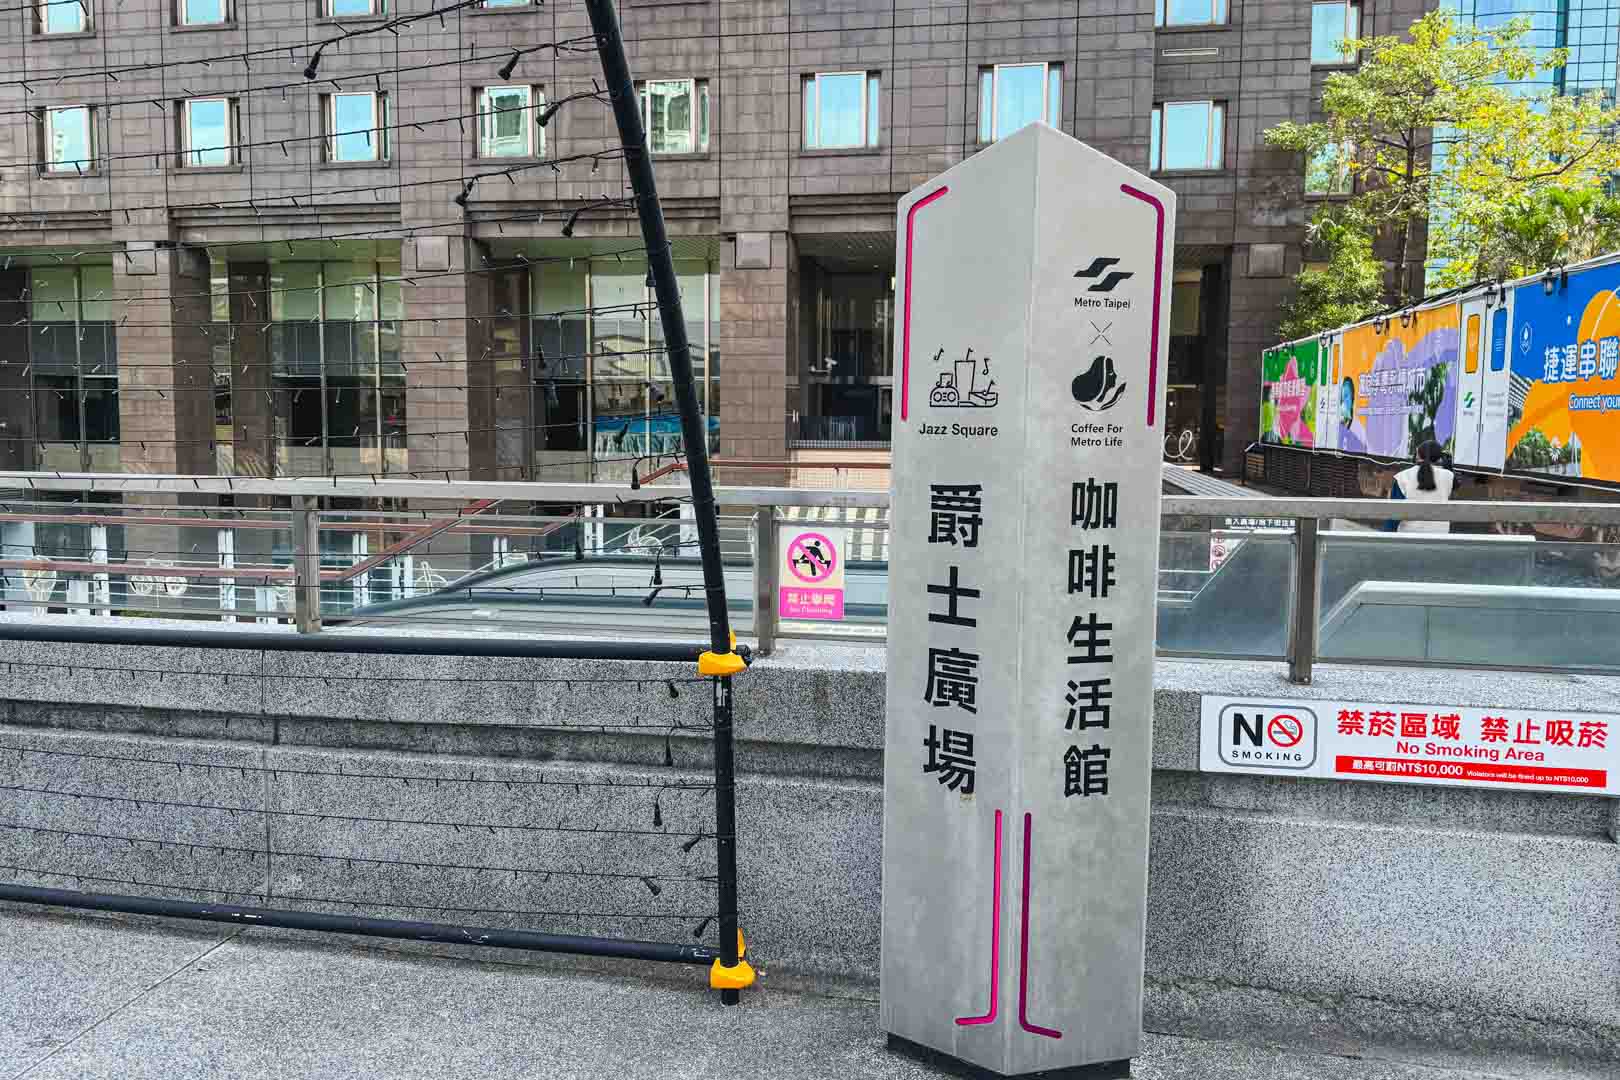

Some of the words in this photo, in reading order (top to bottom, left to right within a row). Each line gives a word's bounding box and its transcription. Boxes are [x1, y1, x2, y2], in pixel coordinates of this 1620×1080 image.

[1074, 297, 1101, 308] Metro
[1104, 298, 1130, 310] Taipei
[1543, 338, 1619, 383] 捷運串聯
[1568, 394, 1600, 409] Connect
[919, 423, 948, 435] Jazz
[951, 423, 998, 438] Square
[1071, 424, 1104, 433] Coffee
[1107, 424, 1123, 433] For
[1071, 437, 1102, 447] Metro
[1105, 437, 1123, 447] Life
[923, 484, 983, 794] 爵士廣場
[1063, 478, 1118, 797] 咖啡生活館
[1337, 709, 1461, 741] 禁菸區域
[1480, 716, 1609, 749] 禁止吸菸
[1232, 750, 1302, 761] SMOKING
[1396, 741, 1420, 755] No
[1425, 743, 1500, 762] Smoking
[1504, 747, 1545, 762] Area
